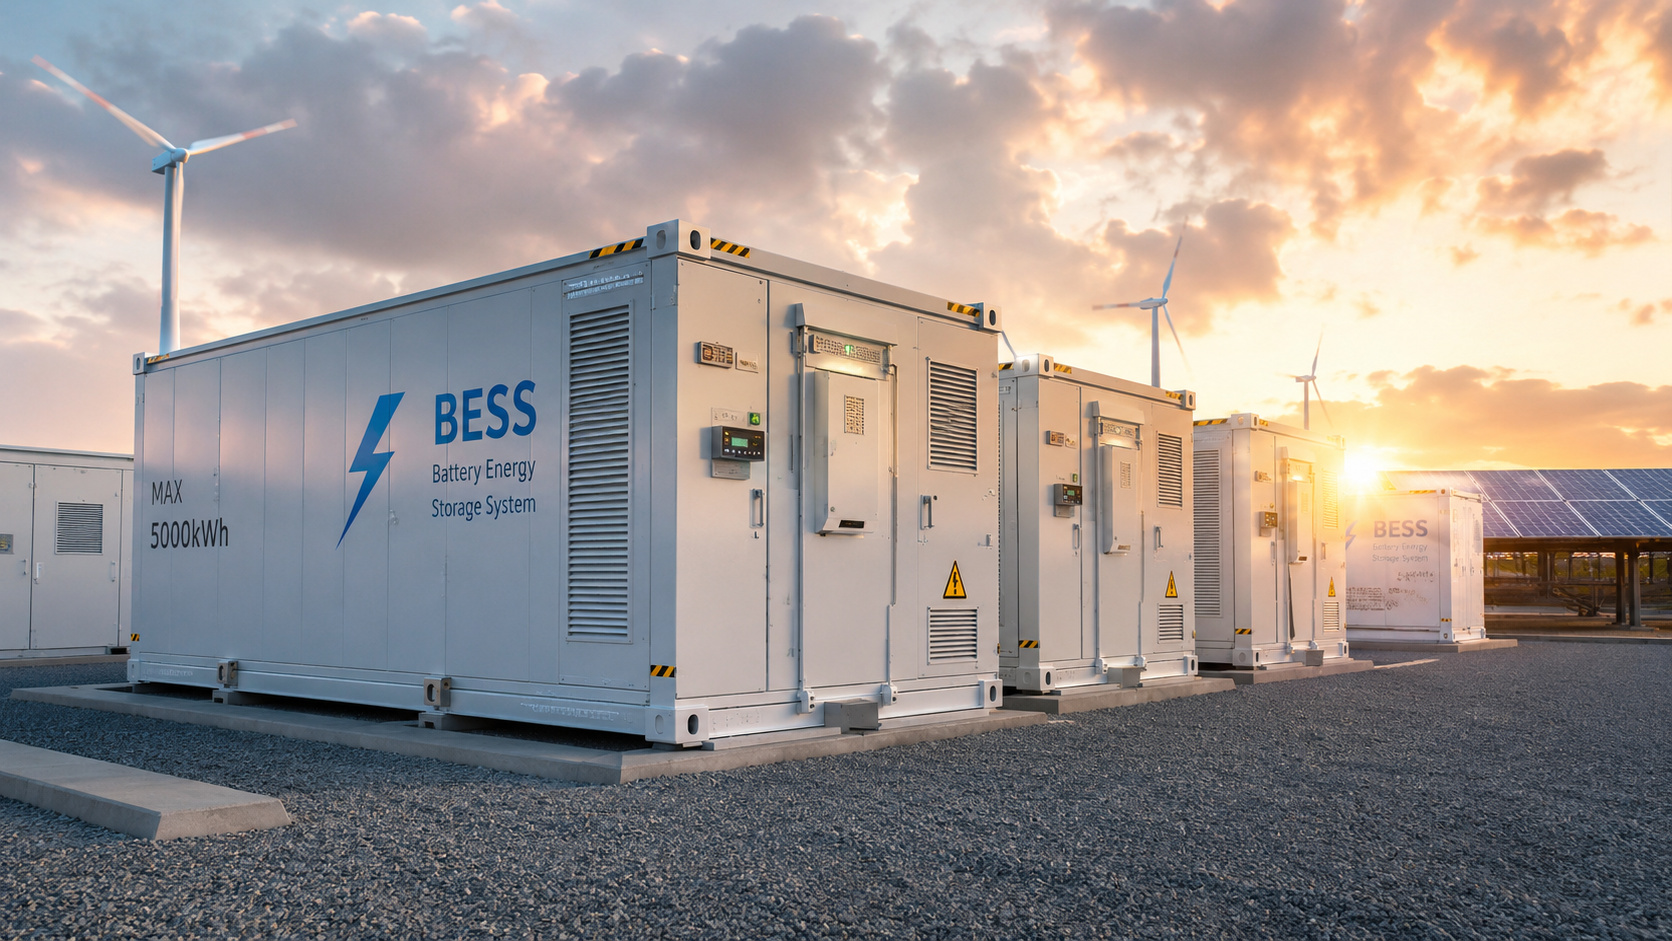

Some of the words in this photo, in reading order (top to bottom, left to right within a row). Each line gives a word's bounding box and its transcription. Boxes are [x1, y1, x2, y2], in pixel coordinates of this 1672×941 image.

[434, 379, 537, 446] BESS
[432, 463, 482, 486] Battery
[486, 458, 536, 483] Energy
[151, 479, 183, 506] MAX
[431, 498, 482, 521] Storage
[485, 494, 536, 520] System
[150, 517, 229, 549] 5000kWh
[1373, 519, 1428, 538] BESS
